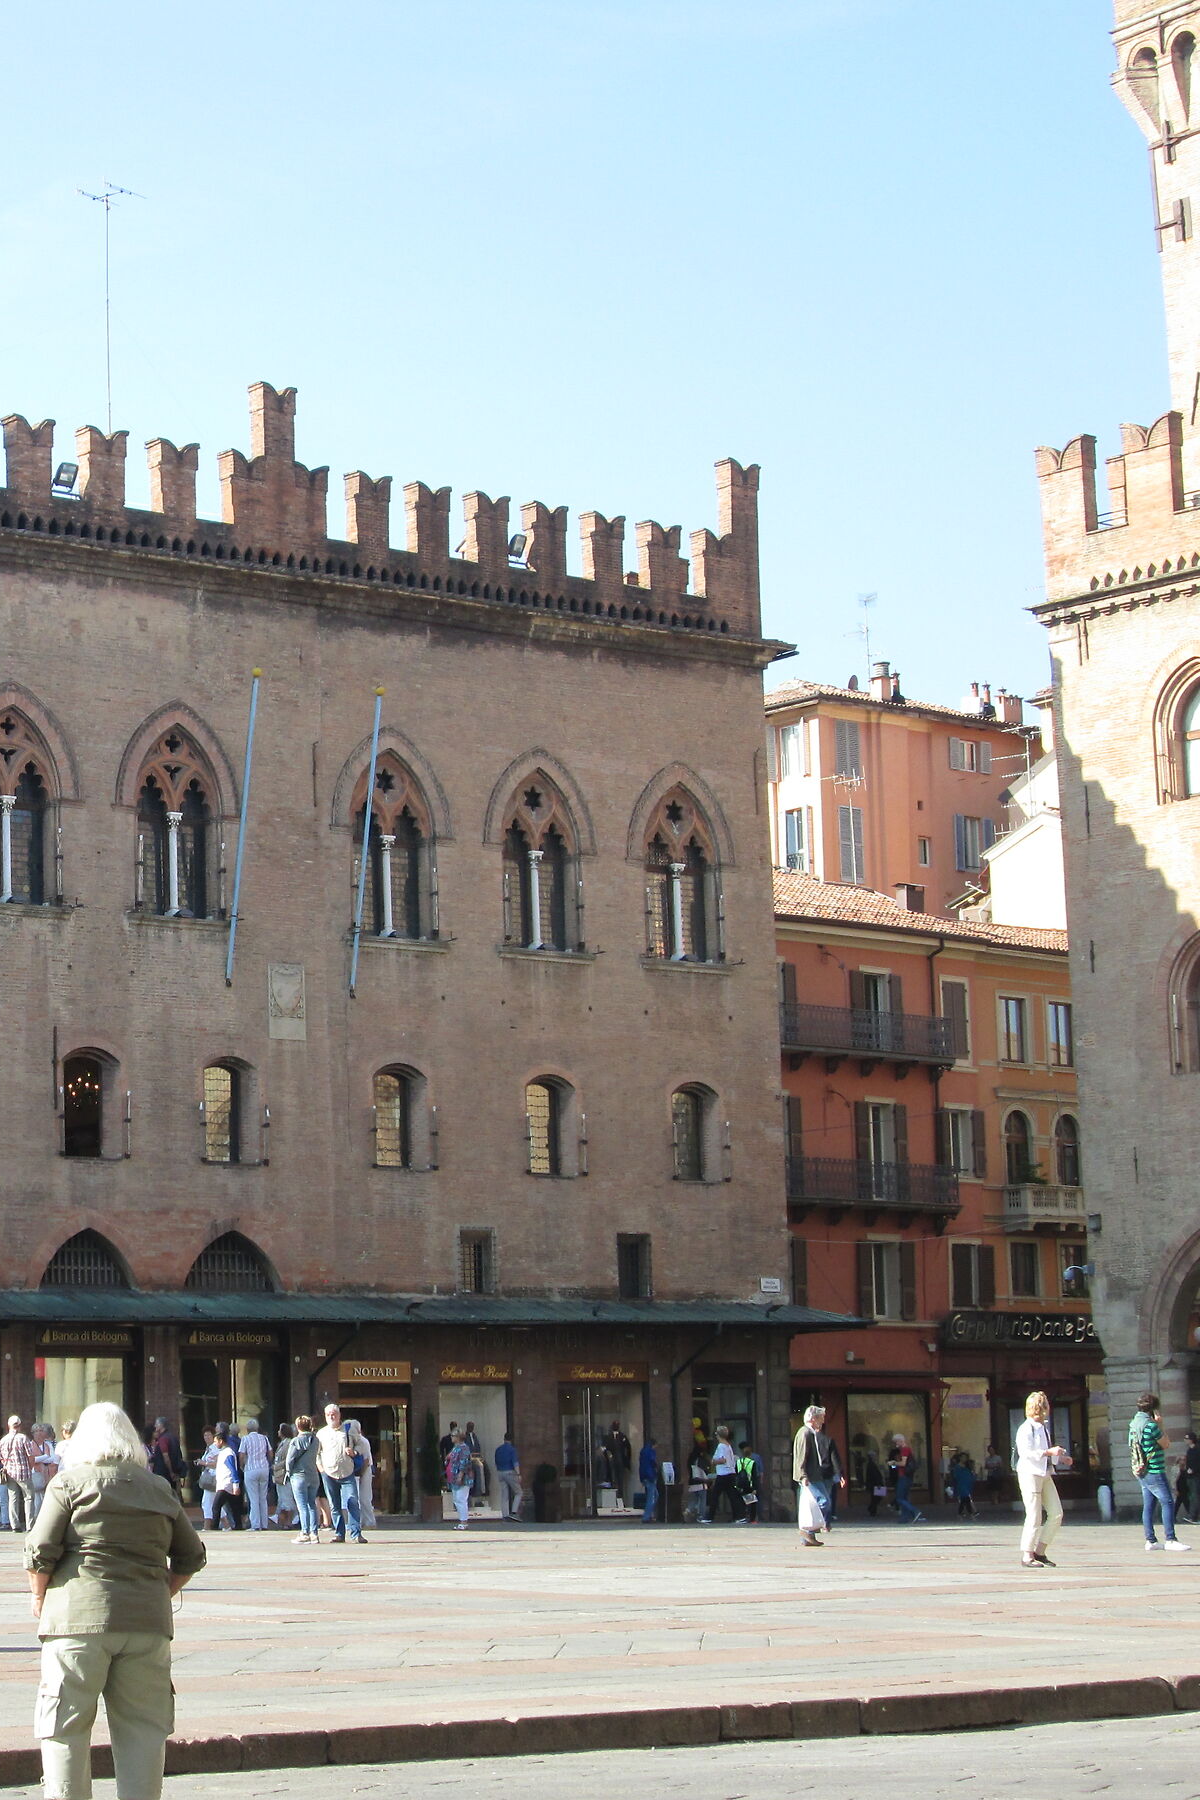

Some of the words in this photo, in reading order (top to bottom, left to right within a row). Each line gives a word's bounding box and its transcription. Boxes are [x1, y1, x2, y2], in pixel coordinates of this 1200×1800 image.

[52, 1330, 79, 1341] Banca
[80, 1330, 90, 1341] di
[91, 1330, 129, 1343] Bologna
[199, 1331, 224, 1342] Banca
[226, 1331, 235, 1342] di
[236, 1331, 272, 1345] Bologna
[353, 1367, 398, 1377] NOTARI
